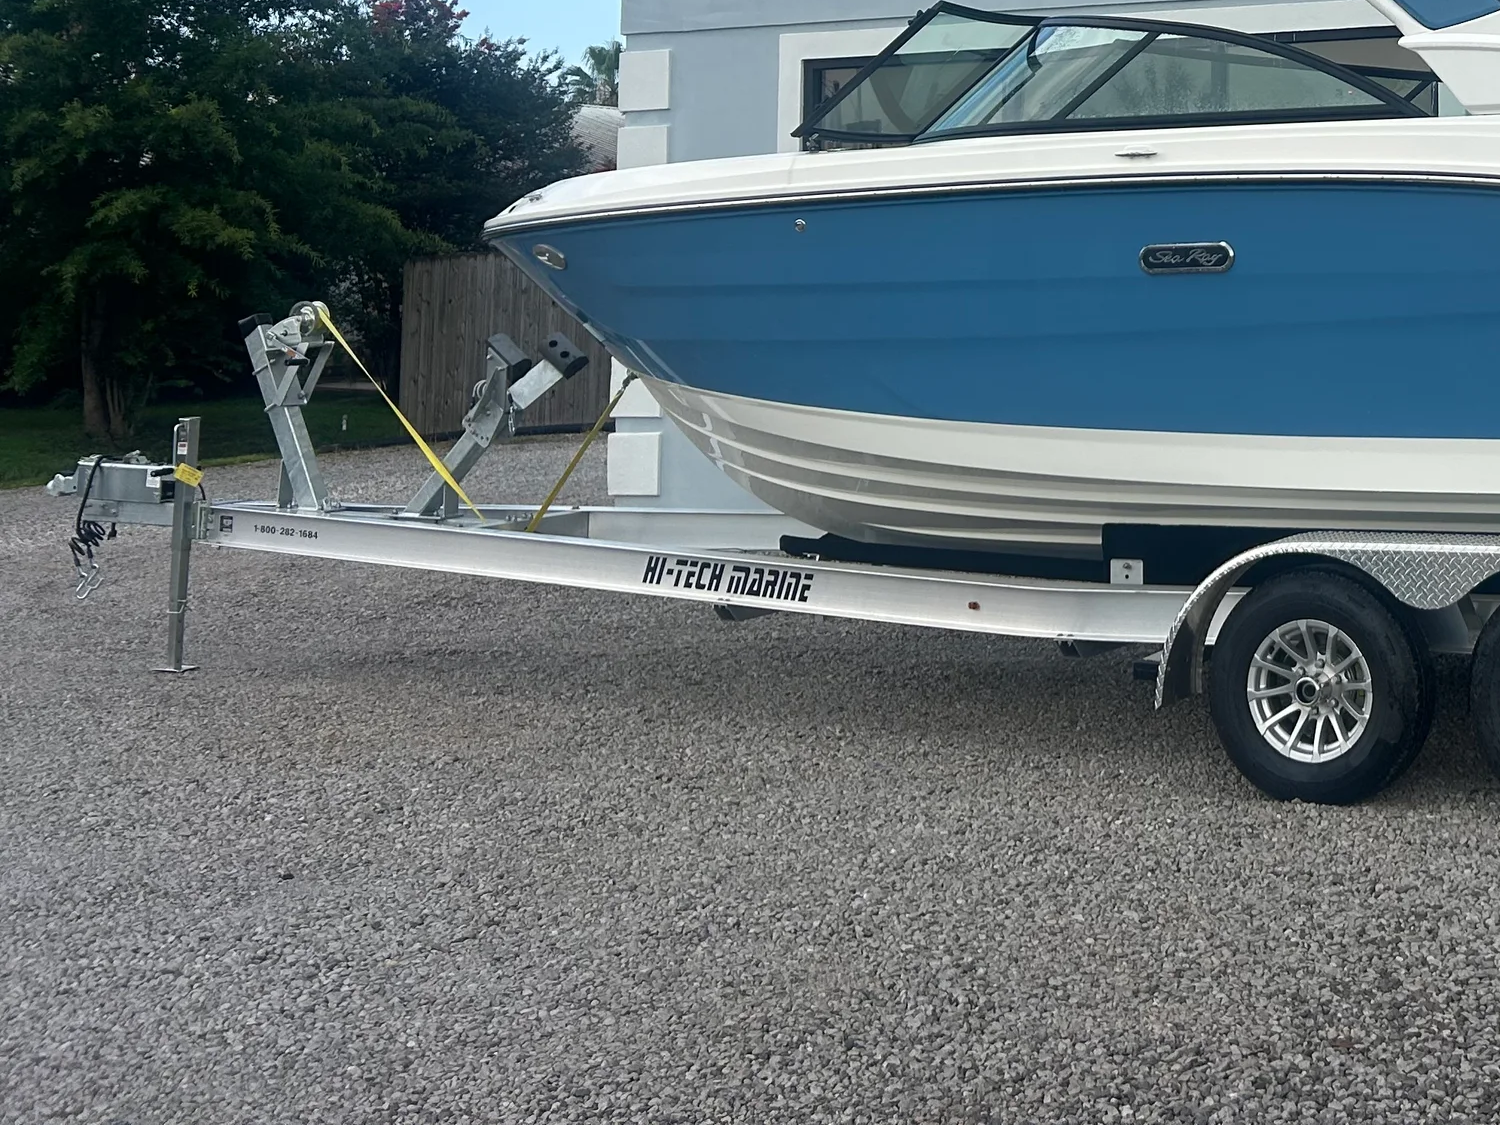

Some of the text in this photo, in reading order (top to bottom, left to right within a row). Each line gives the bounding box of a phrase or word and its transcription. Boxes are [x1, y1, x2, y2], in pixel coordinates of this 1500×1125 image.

[1148, 248, 1223, 266] Sea Ray
[253, 524, 318, 539] 1-800-282-1684
[642, 555, 814, 603] HI-TECH MARINE
